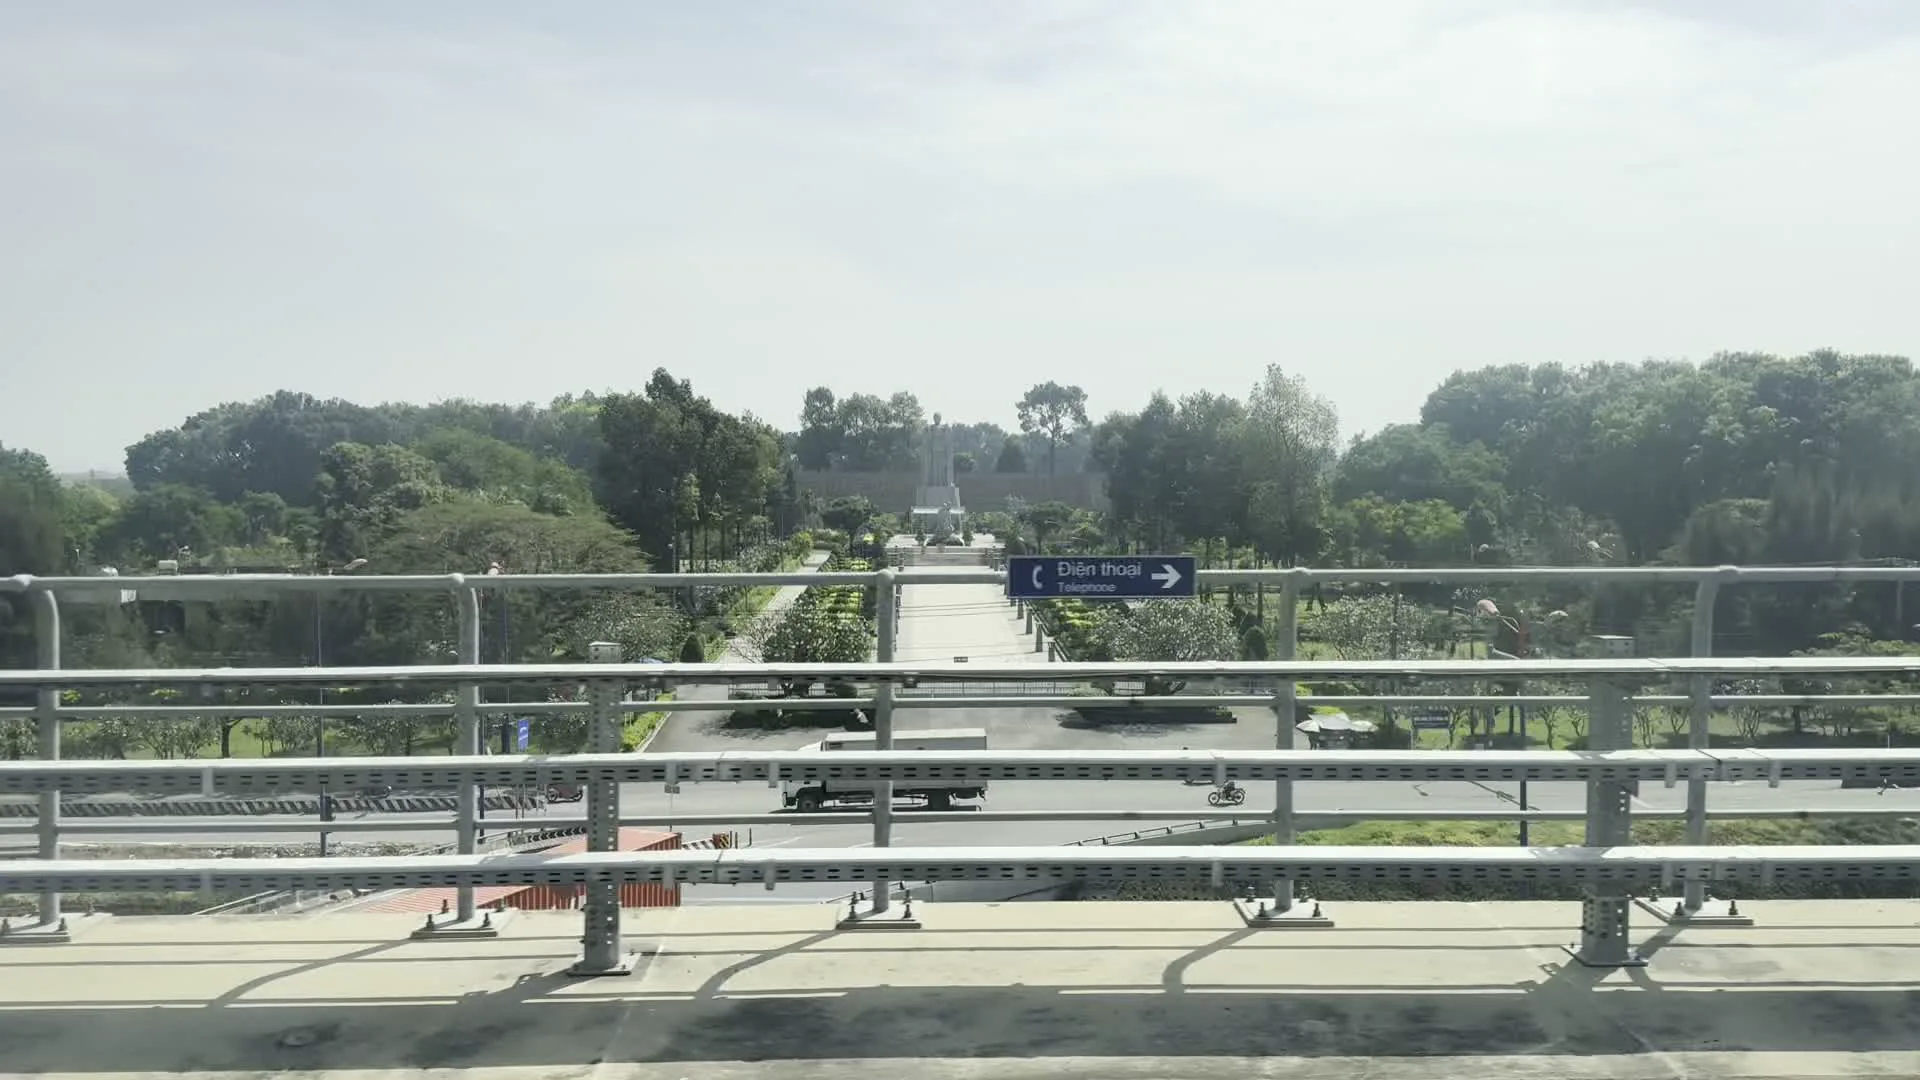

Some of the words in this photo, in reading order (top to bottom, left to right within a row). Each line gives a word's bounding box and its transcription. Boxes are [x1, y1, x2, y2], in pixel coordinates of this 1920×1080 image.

[1057, 561, 1096, 578] Điện
[1101, 561, 1141, 578] thoại
[1057, 581, 1116, 593] Telephone
